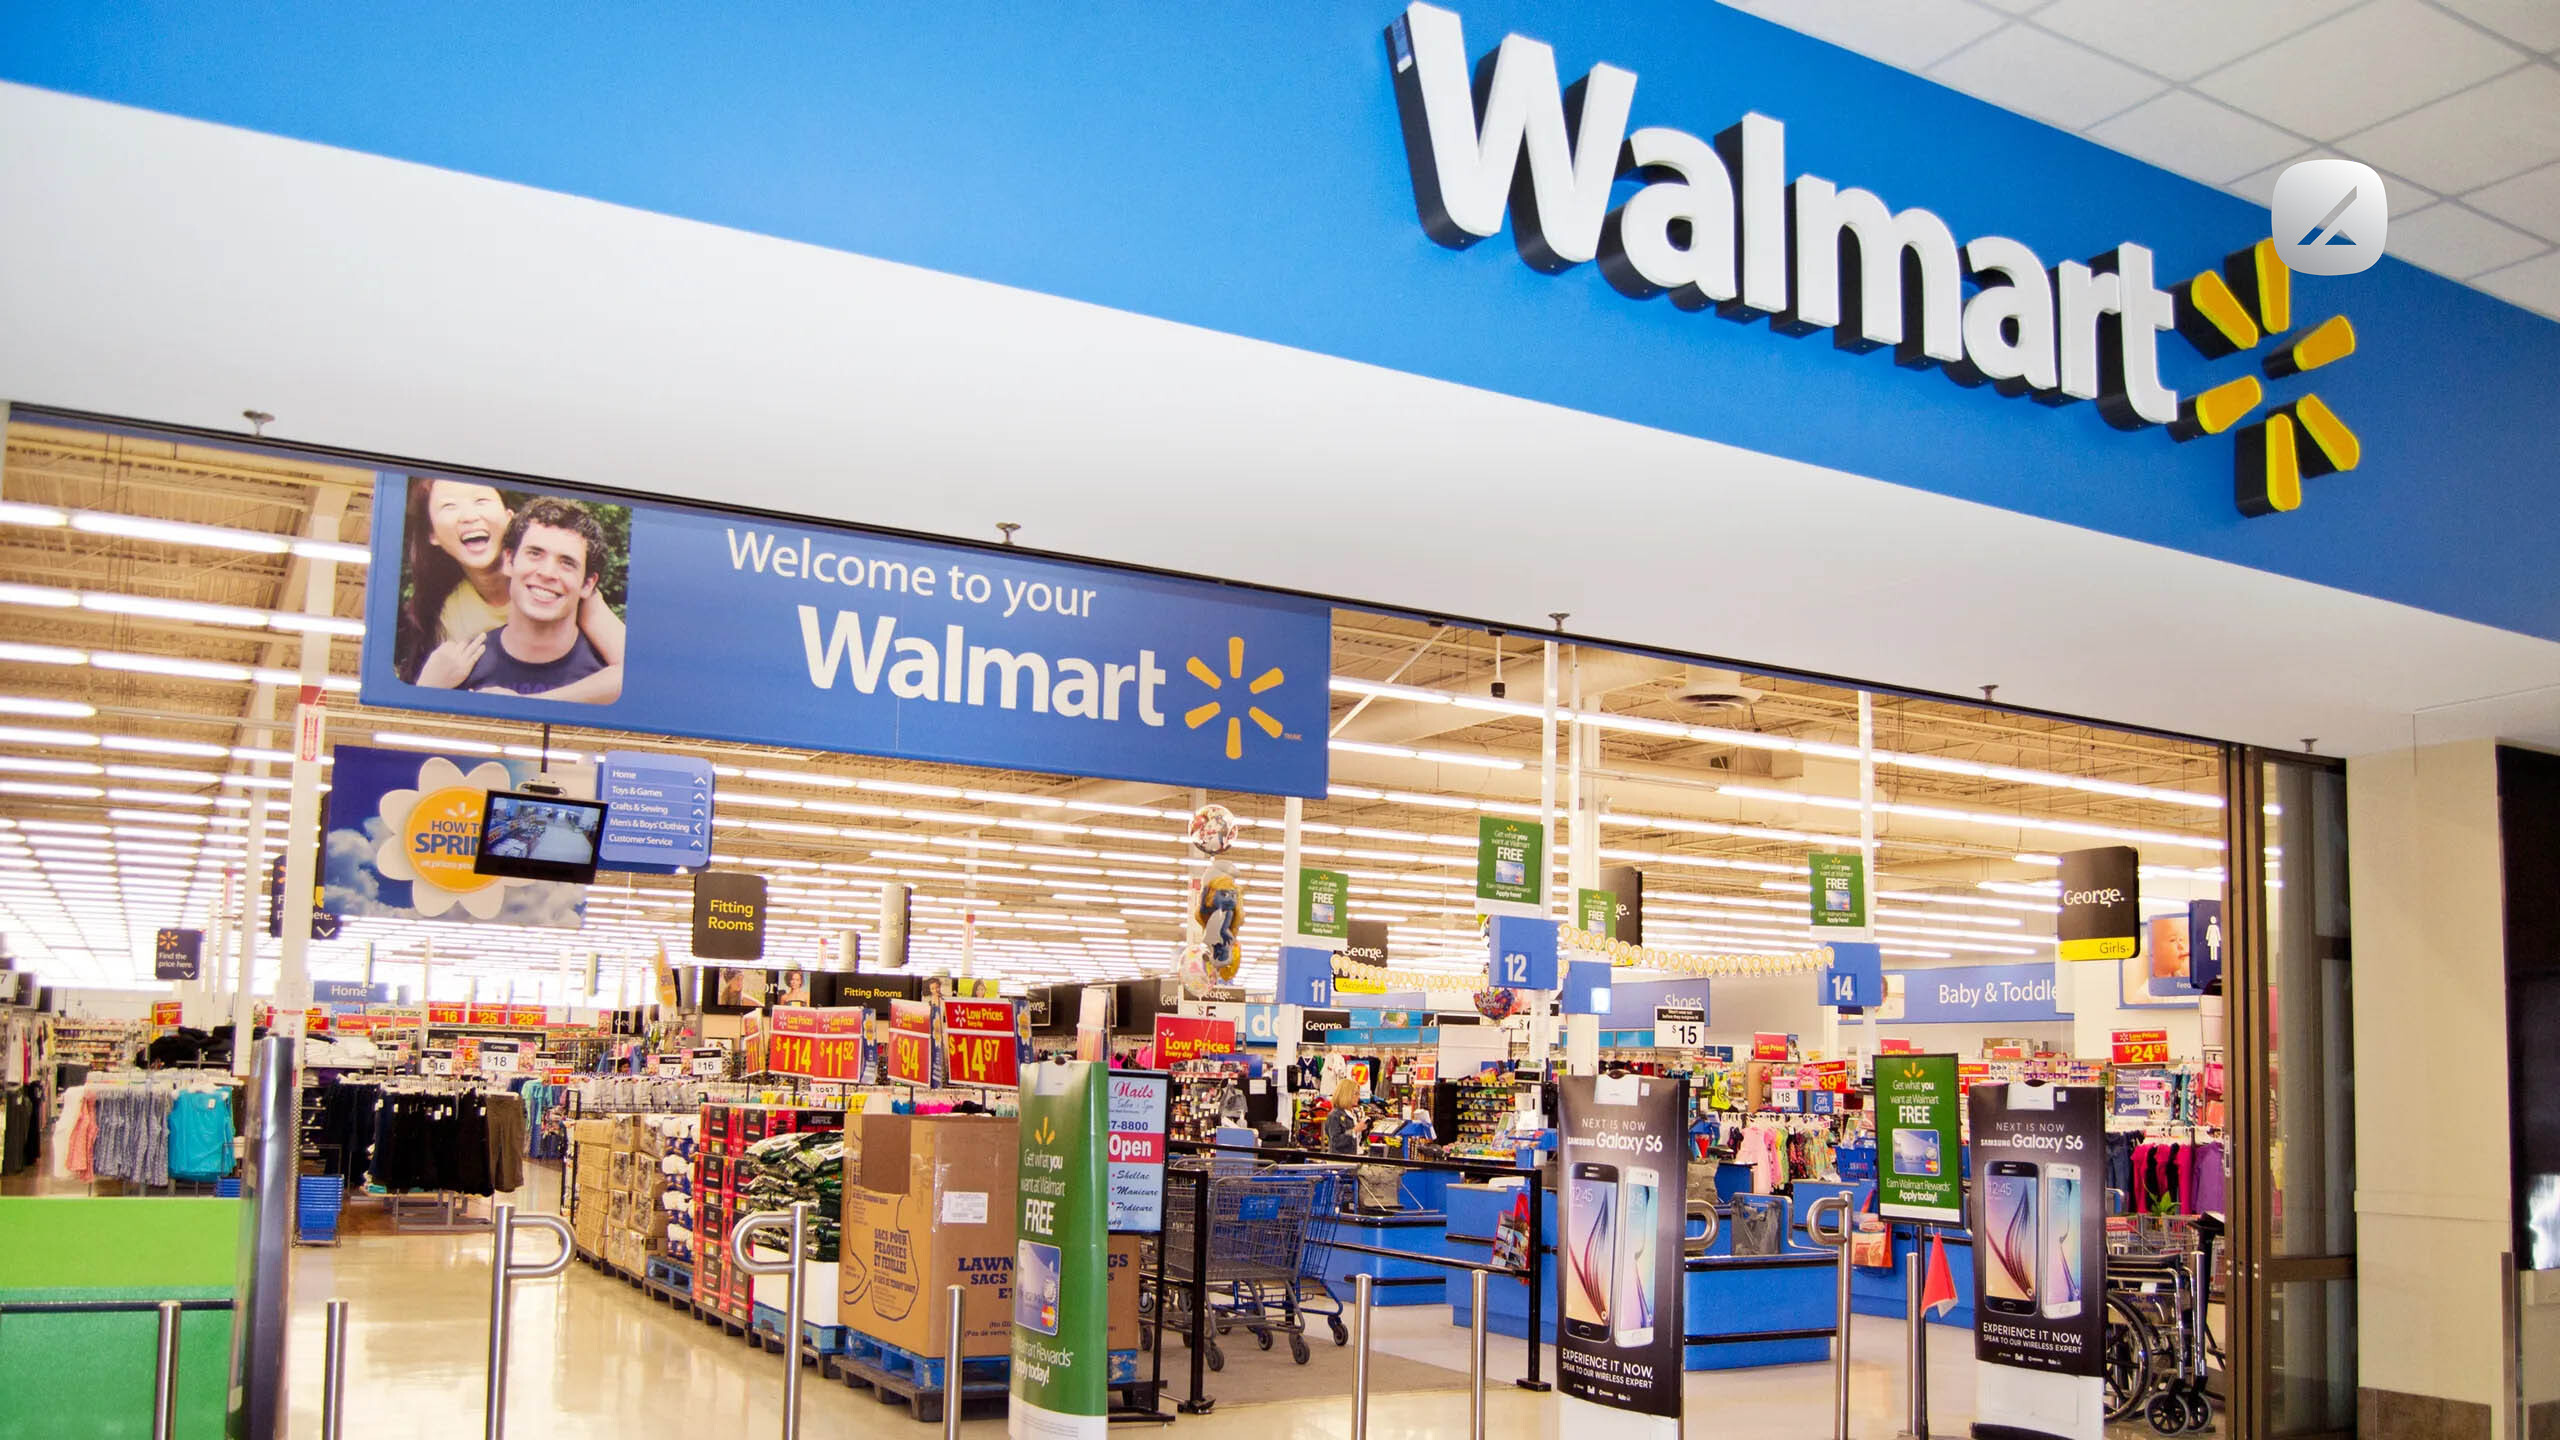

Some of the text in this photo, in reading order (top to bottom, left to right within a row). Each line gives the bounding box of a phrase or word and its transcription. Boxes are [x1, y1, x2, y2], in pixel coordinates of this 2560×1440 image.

[1407, 2, 2178, 426] Walmart
[726, 527, 1096, 618] Welcome to your
[797, 604, 1167, 727] Walmart
[612, 770, 637, 779] Home
[612, 786, 628, 796] Toys
[637, 788, 663, 797] Games
[611, 801, 632, 811] Crafts
[641, 804, 669, 815] Sewing
[431, 820, 481, 834] HOW T
[658, 822, 690, 833] Clothing
[608, 833, 673, 847] Customer Service
[1497, 847, 1525, 862] FREE
[1826, 878, 1848, 889] FREE
[1312, 892, 1334, 904] FREE
[2063, 887, 2125, 908] George.
[312, 911, 333, 921] ere.
[710, 899, 754, 918] Fitting
[1588, 910, 1605, 920] FREE
[708, 916, 755, 931] Rooms
[159, 952, 187, 960] Find the
[158, 960, 193, 969] price here.
[1505, 953, 1527, 983] 12
[331, 984, 367, 997] Home
[844, 987, 903, 999] Fitting Rooms
[1311, 979, 1326, 1003] 11
[1832, 976, 1853, 1001] 14
[1939, 984, 1979, 1008] Baby
[1984, 983, 1998, 1003] &
[1664, 993, 1702, 1008] Shoes
[787, 1014, 813, 1025] Low Prices
[830, 1015, 854, 1025] Low Prices
[903, 1013, 912, 1022] Low
[966, 1007, 1004, 1021] Low Prices
[1671, 1025, 1697, 1045] $15
[1165, 1037, 1230, 1053] Low Prices
[487, 1056, 507, 1067] $18
[775, 1036, 812, 1073] $114
[898, 1037, 920, 1080] $94
[1114, 1081, 1154, 1099] Nails
[1893, 1080, 1935, 1092] Get what you
[1890, 1095, 1939, 1105] want at Walmart
[1899, 1106, 1931, 1125] FREE
[1108, 1120, 1149, 1131] 7-8800
[1582, 1118, 1647, 1132] NEXT IS NOW
[1995, 1122, 2065, 1133] NEXT IS NOW
[1109, 1134, 1152, 1161] Open
[1567, 1131, 1663, 1155] SAMSUNG Galaxy S6
[1980, 1133, 2084, 1153] SAMSUNG Galaxy S6
[1024, 1149, 1063, 1173] Get what you
[1117, 1170, 1150, 1180] Shellac
[1039, 1176, 1065, 1197] Walmart
[1116, 1186, 1159, 1197] Manicure
[1899, 1190, 1938, 1203] Apply today!
[1116, 1202, 1153, 1212] Pedicure
[1024, 1198, 1056, 1236] FREE
[874, 1228, 908, 1246] SACS POUR
[874, 1241, 907, 1260] PELOUSES
[881, 1256, 907, 1274] FEUILLES
[958, 1256, 1014, 1272] LAWN
[970, 1273, 1008, 1285] SACS
[1983, 1321, 2036, 1339] EXPERIENCE
[2039, 1330, 2048, 1341] IT
[1983, 1334, 2000, 1343] SPEAK
[2022, 1341, 2054, 1351] WIRELESS
[2055, 1344, 2083, 1354] EXPERT
[1562, 1348, 1607, 1370] EXPERIENCE
[1610, 1360, 1620, 1372] IT
[1028, 1361, 1050, 1387] today!
[1562, 1361, 1653, 1389] SPEAK TO OUR WIRELESS EXPERT
